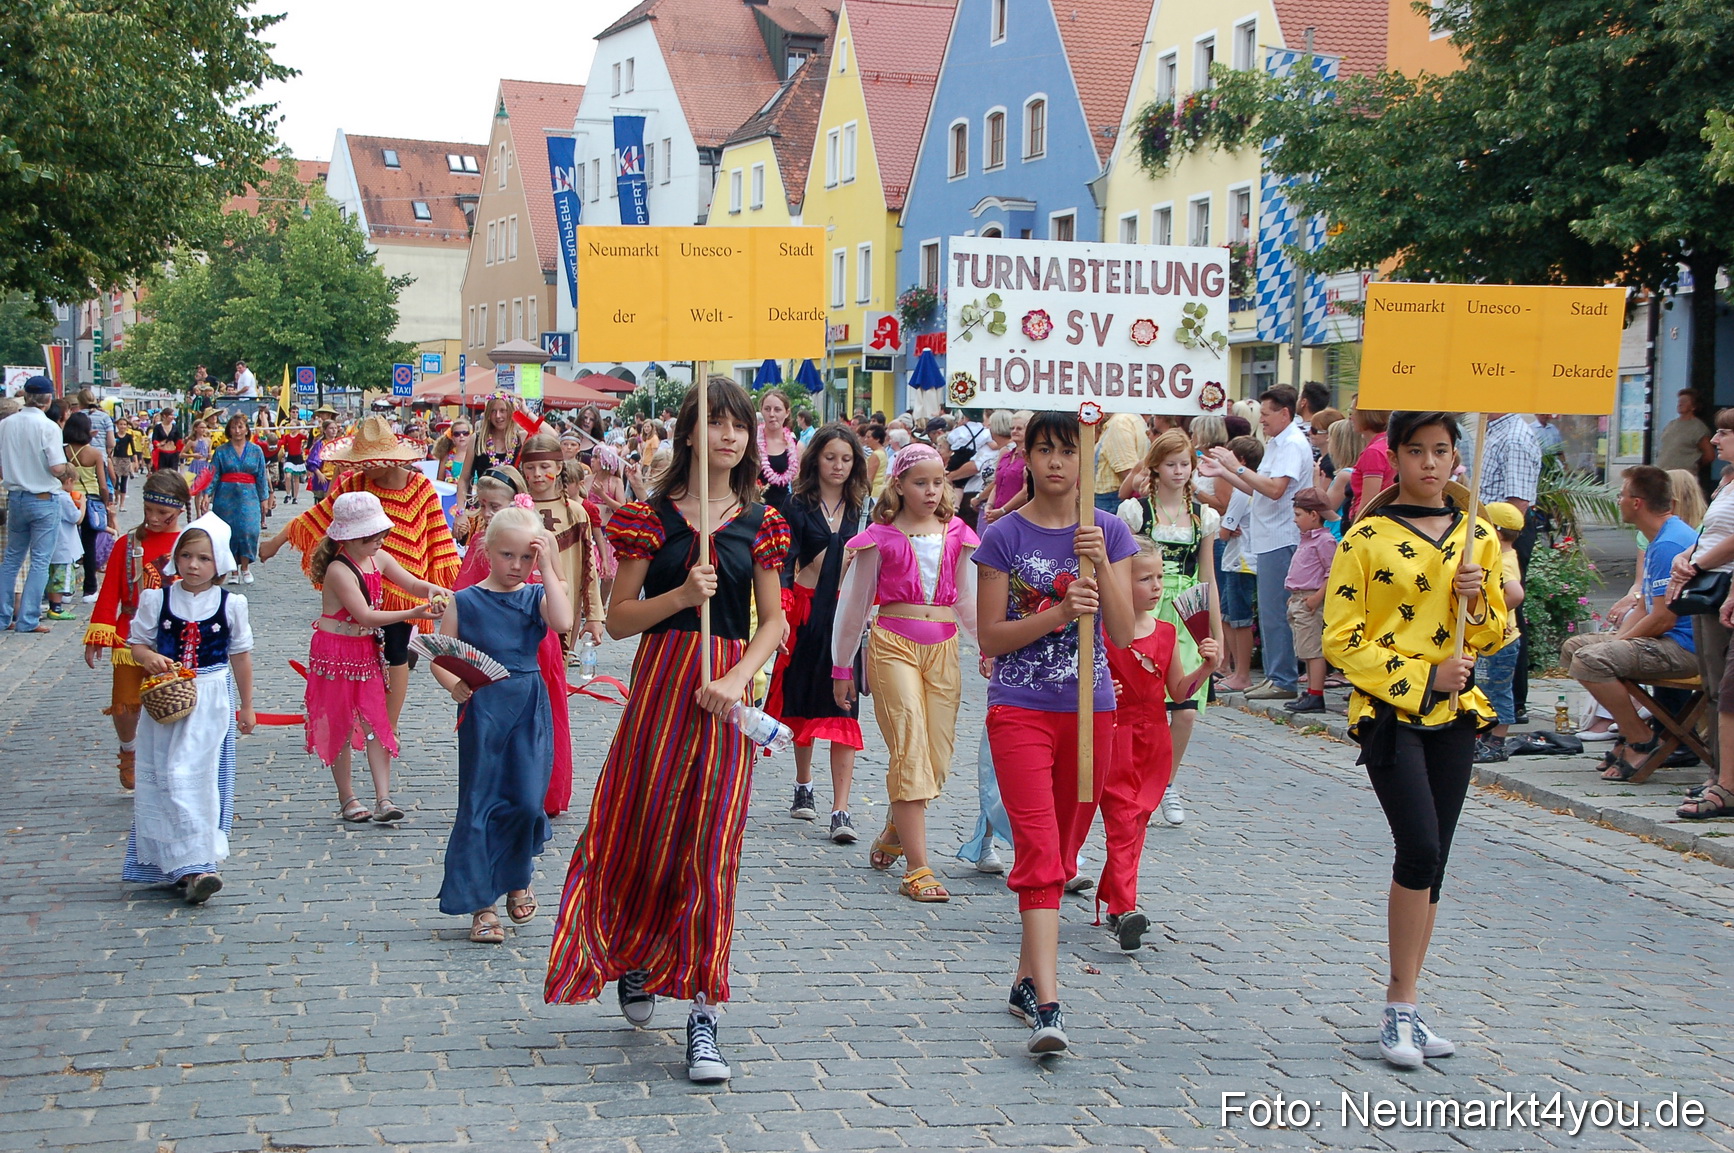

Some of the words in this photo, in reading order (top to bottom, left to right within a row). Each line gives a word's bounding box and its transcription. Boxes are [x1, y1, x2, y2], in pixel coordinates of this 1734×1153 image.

[588, 242, 659, 257] Neumarkt
[779, 242, 814, 257] Stadt
[953, 252, 1225, 298] TURNABTEILUNG
[612, 308, 636, 324] der
[768, 306, 825, 322] Dekarde
[1373, 298, 1446, 314] Neumarkt
[1570, 301, 1608, 317] Stadt
[1066, 310, 1114, 347] SV
[980, 348, 1194, 399] HÖHENBERG
[1391, 360, 1416, 376] der
[1552, 364, 1614, 380] Dekarde
[299, 384, 314, 392] TAXI
[395, 386, 411, 395] TAXI
